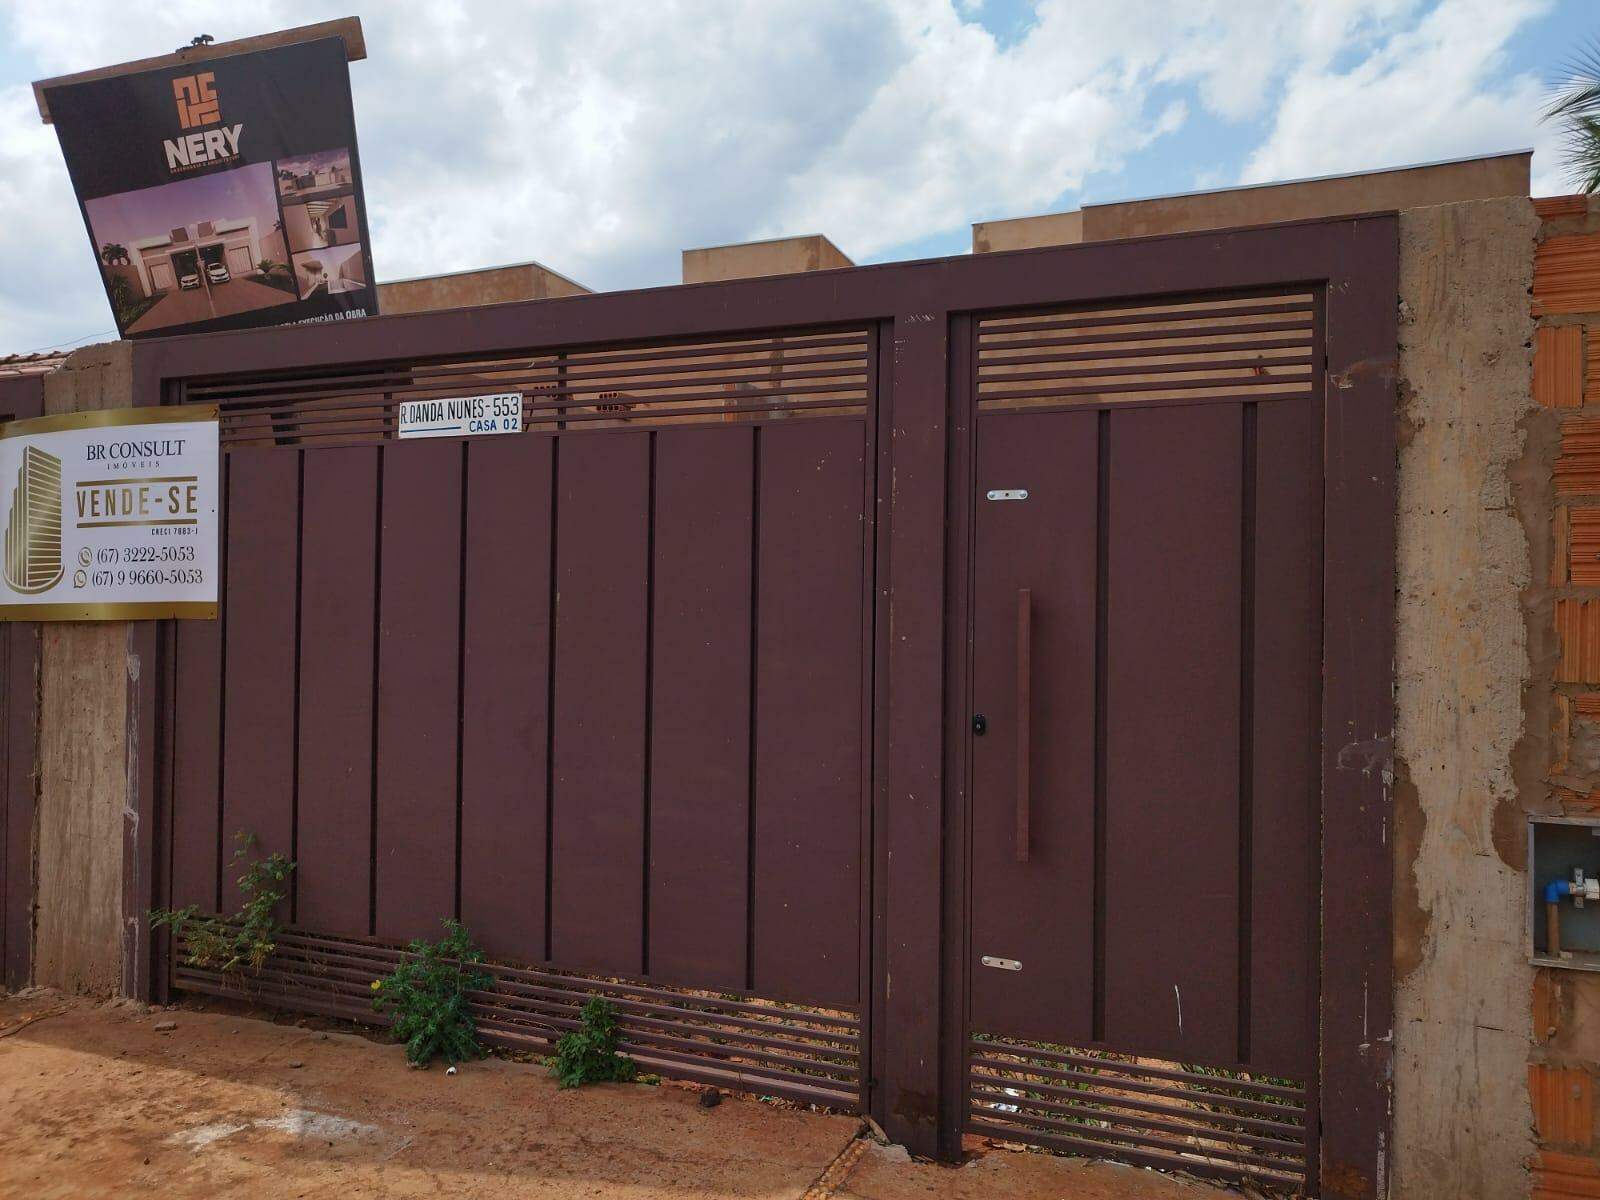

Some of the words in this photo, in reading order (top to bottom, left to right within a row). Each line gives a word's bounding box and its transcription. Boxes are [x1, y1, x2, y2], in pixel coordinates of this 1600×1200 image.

[163, 123, 243, 169] NERY
[346, 308, 367, 320] OBRA
[469, 420, 497, 433] CASA
[503, 418, 518, 430] 02
[87, 444, 106, 460] BR
[109, 440, 185, 459] CONSULT
[76, 485, 198, 518] VENDE-SE
[151, 527, 171, 536] CRECI
[97, 548, 119, 564] (67)
[123, 546, 195, 563] 3222-5053
[92, 570, 114, 587] (67)
[117, 570, 126, 586] 9
